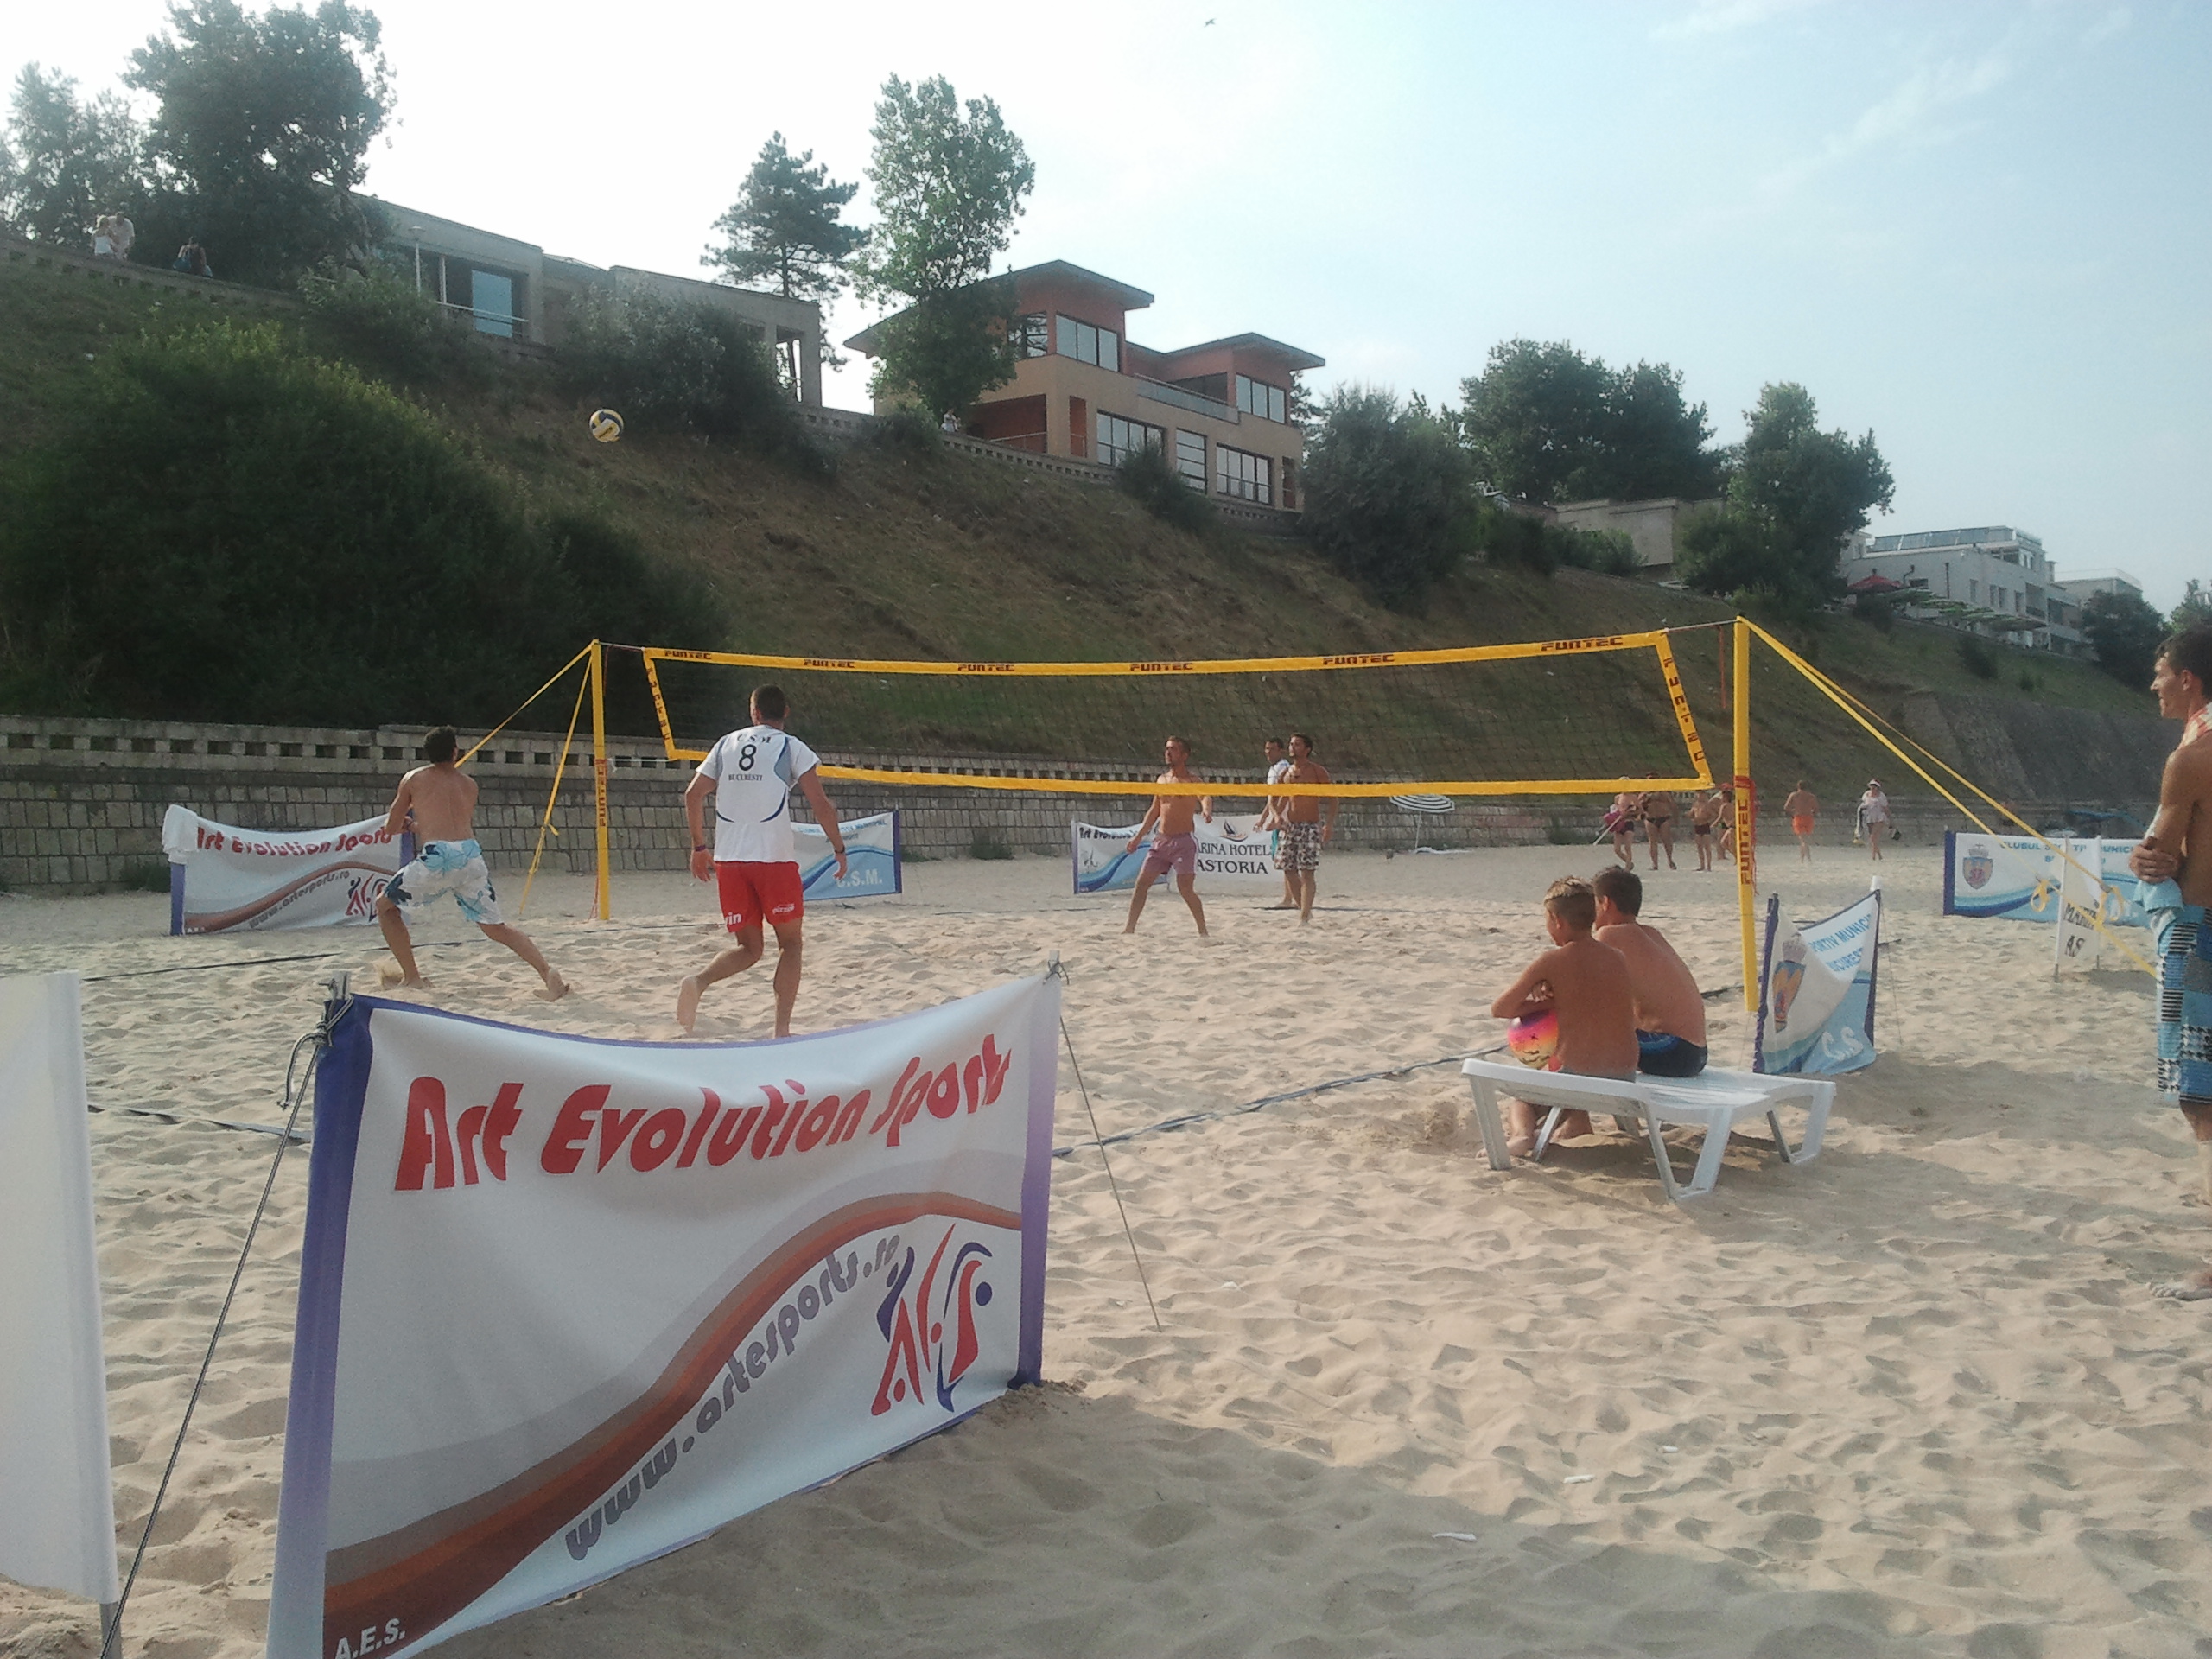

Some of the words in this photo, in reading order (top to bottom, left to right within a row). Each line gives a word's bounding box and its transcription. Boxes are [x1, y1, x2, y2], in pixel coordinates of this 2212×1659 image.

[1541, 637, 1624, 652] FUNTEC
[804, 659, 855, 669] FUNTEC
[1130, 663, 1194, 671] FUNTEC
[1323, 654, 1395, 665] FUNTEC
[957, 664, 1015, 672] FUNTEC
[739, 744, 757, 771] 8
[1738, 798, 1752, 886] FUNTEC
[1229, 844, 1272, 856] HOTEL
[1198, 859, 1268, 874] ASTORIA
[394, 1074, 524, 1192] Art
[539, 1078, 873, 1175] Evolution
[869, 1033, 1013, 1148] Sports
[564, 1234, 901, 1562] www.artesports.ro
[334, 1618, 406, 1659] A.E.S.
